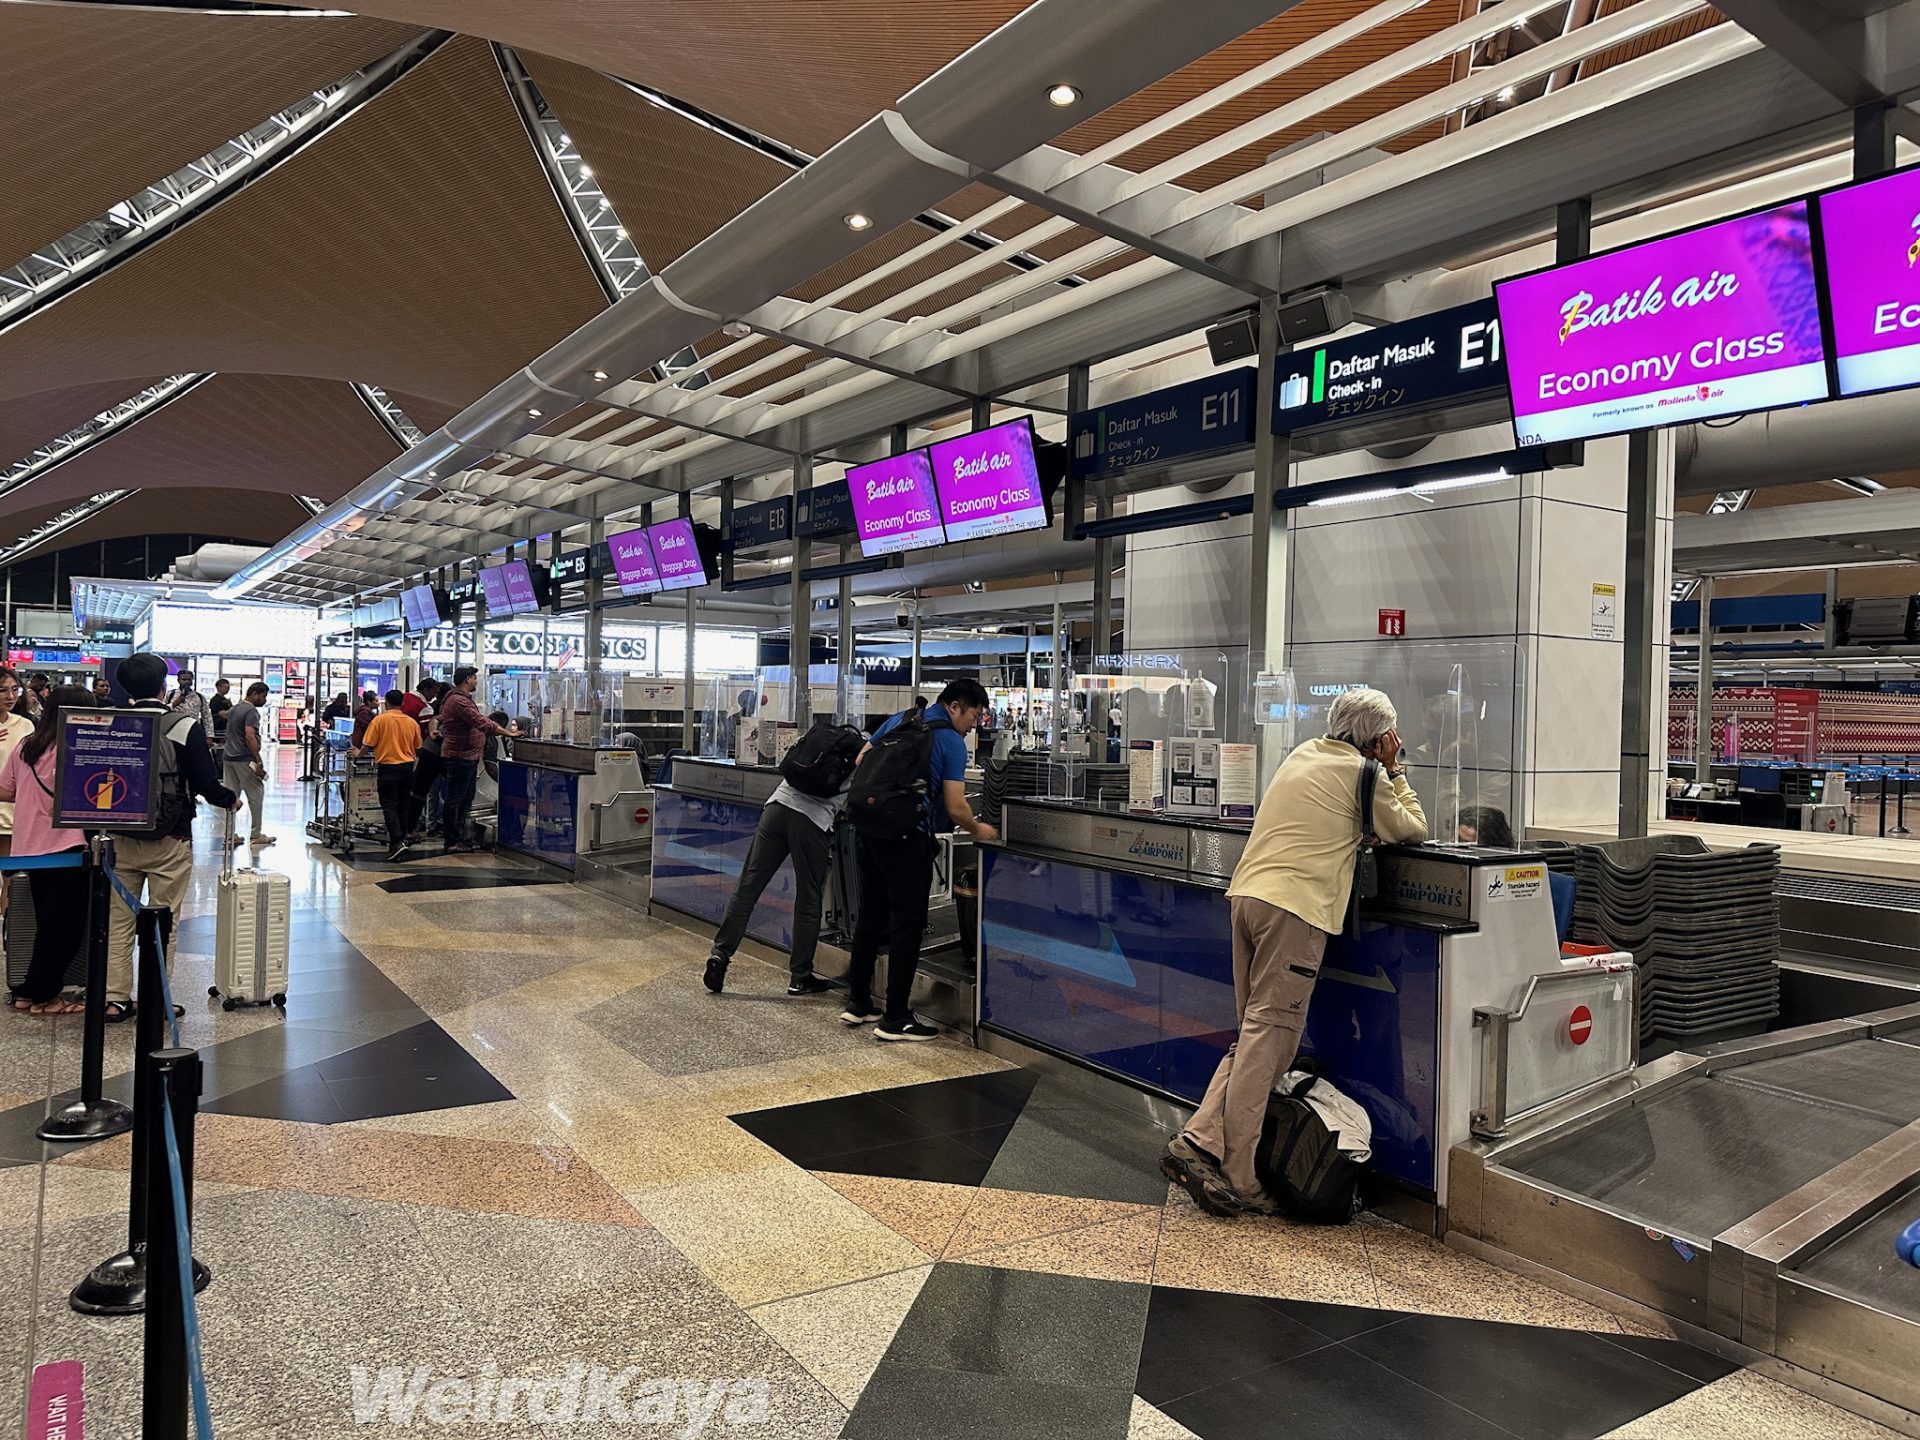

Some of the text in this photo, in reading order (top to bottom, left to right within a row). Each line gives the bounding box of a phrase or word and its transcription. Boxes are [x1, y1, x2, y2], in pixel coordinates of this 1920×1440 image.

[1558, 269, 1740, 344] Batik air
[1329, 337, 1436, 381] Daftar Masuk
[1538, 330, 1785, 400] Economy Class
[1328, 376, 1382, 400] Check-in
[1201, 388, 1240, 431] E11
[1327, 388, 1405, 417] チェックイン
[1592, 408, 1621, 419] Formerly
[1622, 405, 1646, 414] known
[1658, 395, 1696, 408] Malindo
[1711, 388, 1724, 397] air
[1108, 405, 1178, 436] Daftar Masuk
[1108, 436, 1143, 453] Check-in
[1108, 445, 1160, 468] チェックイン
[953, 451, 1012, 482] Batik air
[866, 475, 916, 502] Batik air
[950, 488, 1031, 516] Economy Class
[769, 507, 785, 531] E13
[864, 508, 931, 533] Economy Class
[621, 566, 653, 581] Baggage Drop
[662, 558, 697, 574] Baggage Drop
[484, 631, 499, 653] &
[503, 632, 646, 660] COSMICS
[77, 728, 143, 738] Electronic Cigarettes
[1141, 847, 1184, 861] AIRPORTS
[1145, 841, 1184, 852] MALAYSIA
[1516, 870, 1539, 879] CAUTION
[1397, 887, 1462, 908] AIRPORTS
[1401, 880, 1463, 896] MALAYSIA
[47, 1393, 68, 1424] WAIT
